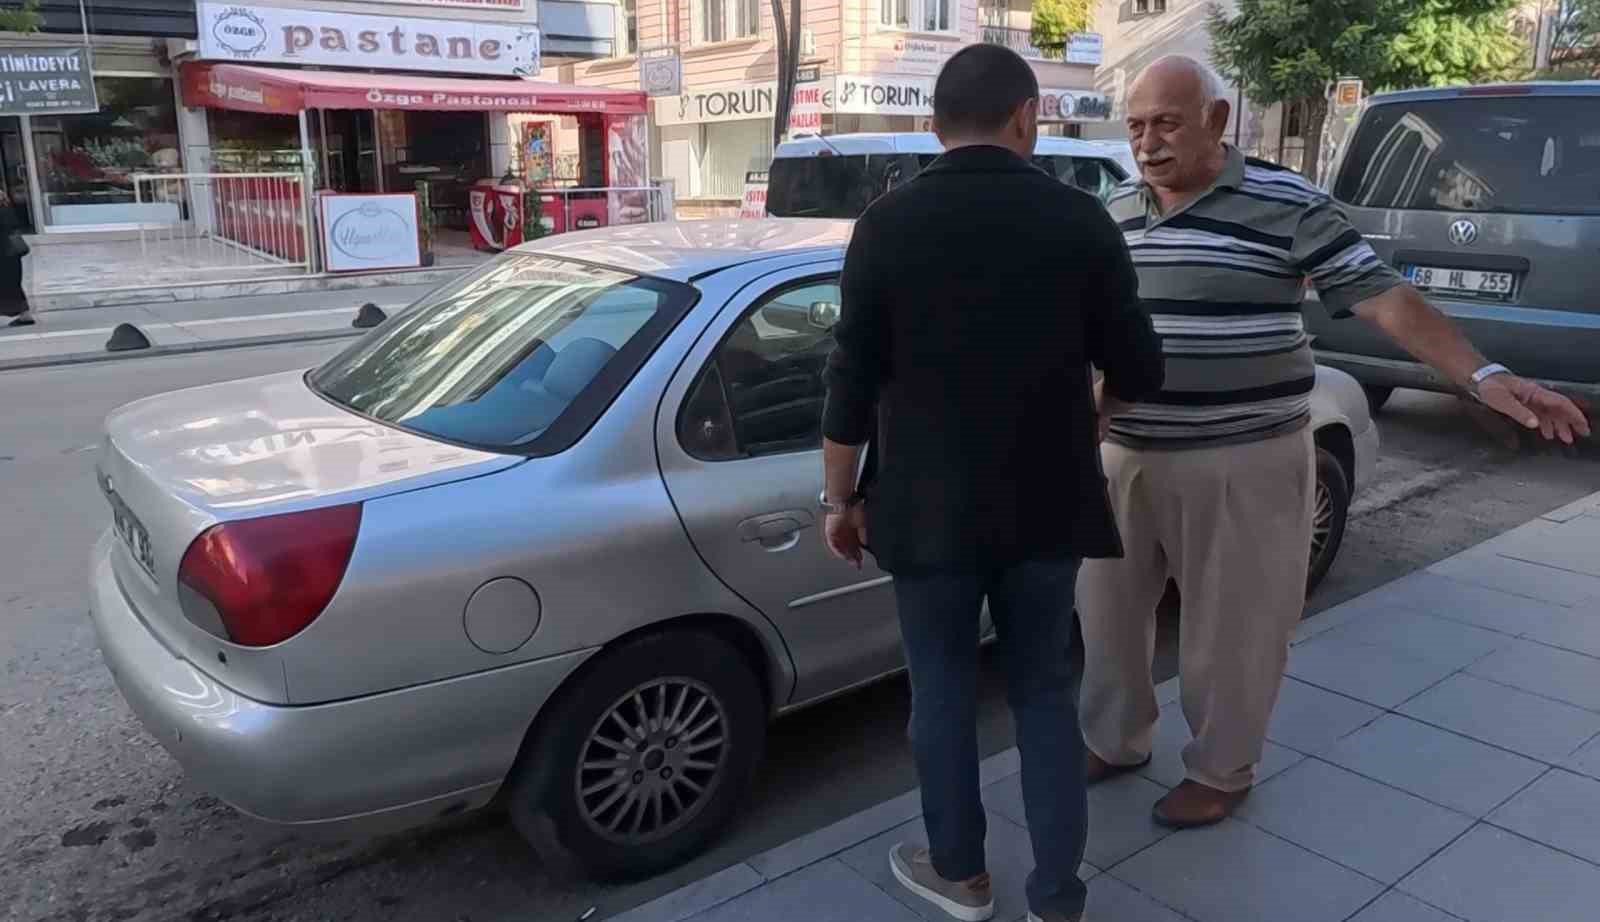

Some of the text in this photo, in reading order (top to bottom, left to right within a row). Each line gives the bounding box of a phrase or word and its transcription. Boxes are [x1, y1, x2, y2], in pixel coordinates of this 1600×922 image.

[281, 24, 501, 61] pastane
[18, 79, 81, 92] LAVERA
[365, 88, 538, 106] Özge Pastanesi
[860, 84, 920, 107] TORUN
[694, 87, 773, 118] TORUN
[1414, 268, 1509, 291] 68 HL 255
